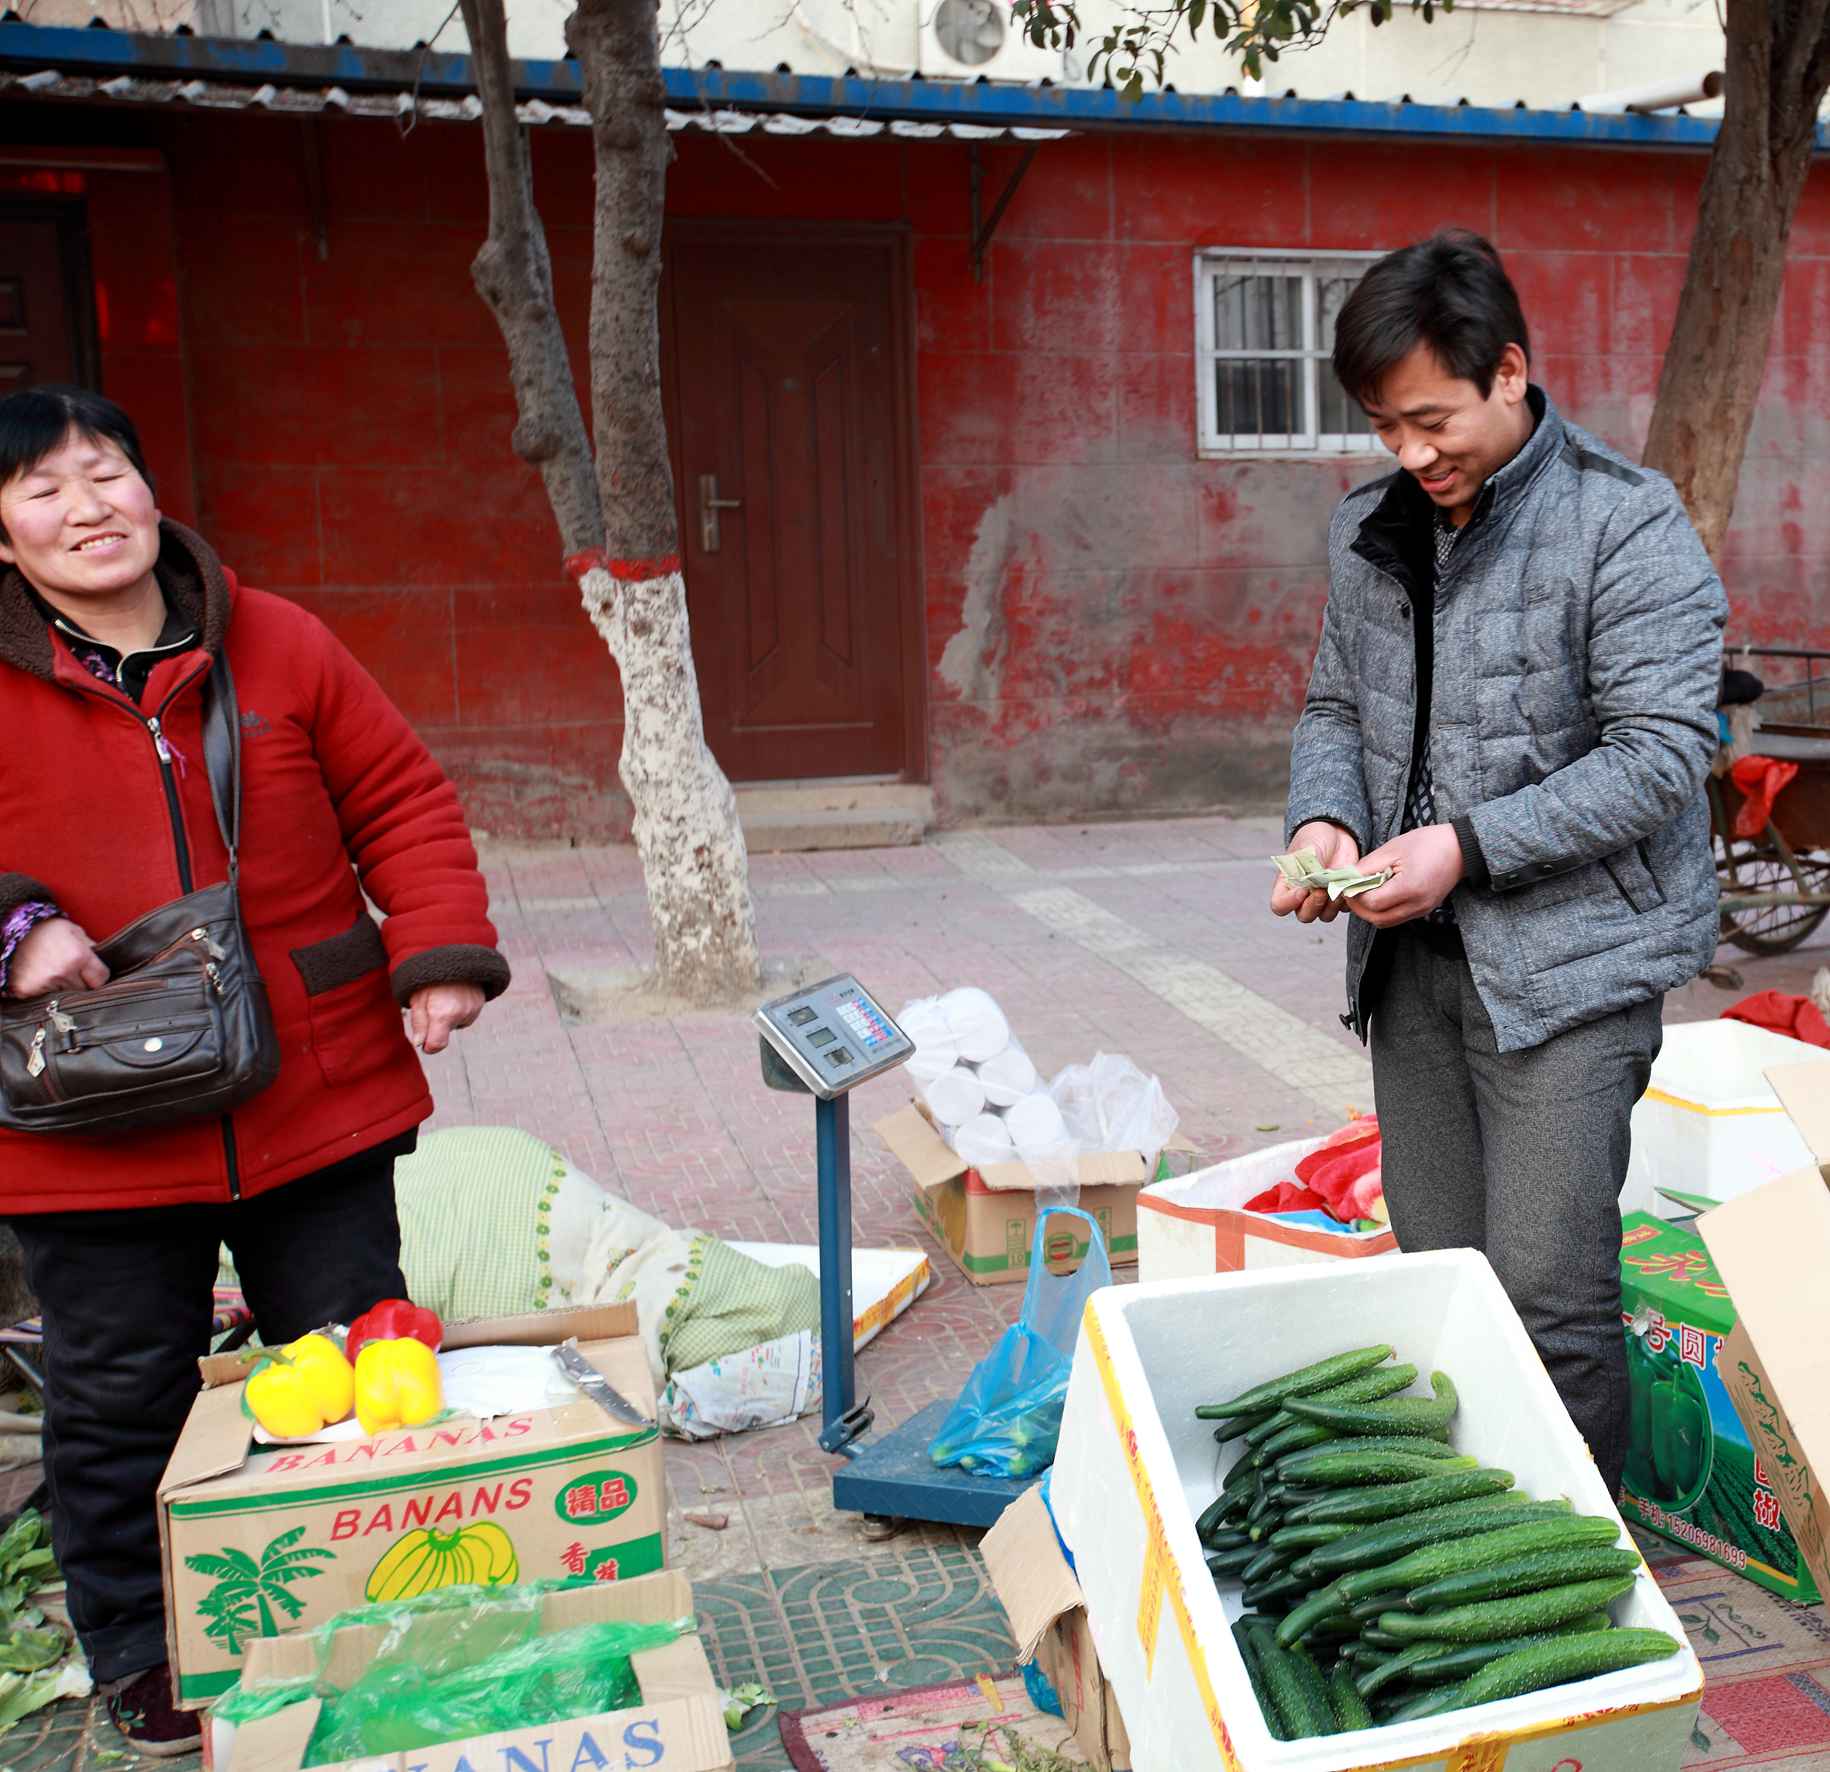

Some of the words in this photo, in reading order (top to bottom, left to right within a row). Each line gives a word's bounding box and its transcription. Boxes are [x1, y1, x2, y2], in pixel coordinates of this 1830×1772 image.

[265, 1417, 533, 1473] BANANAS
[330, 1478, 534, 1541] BANANS
[565, 1479, 629, 1516] 精品
